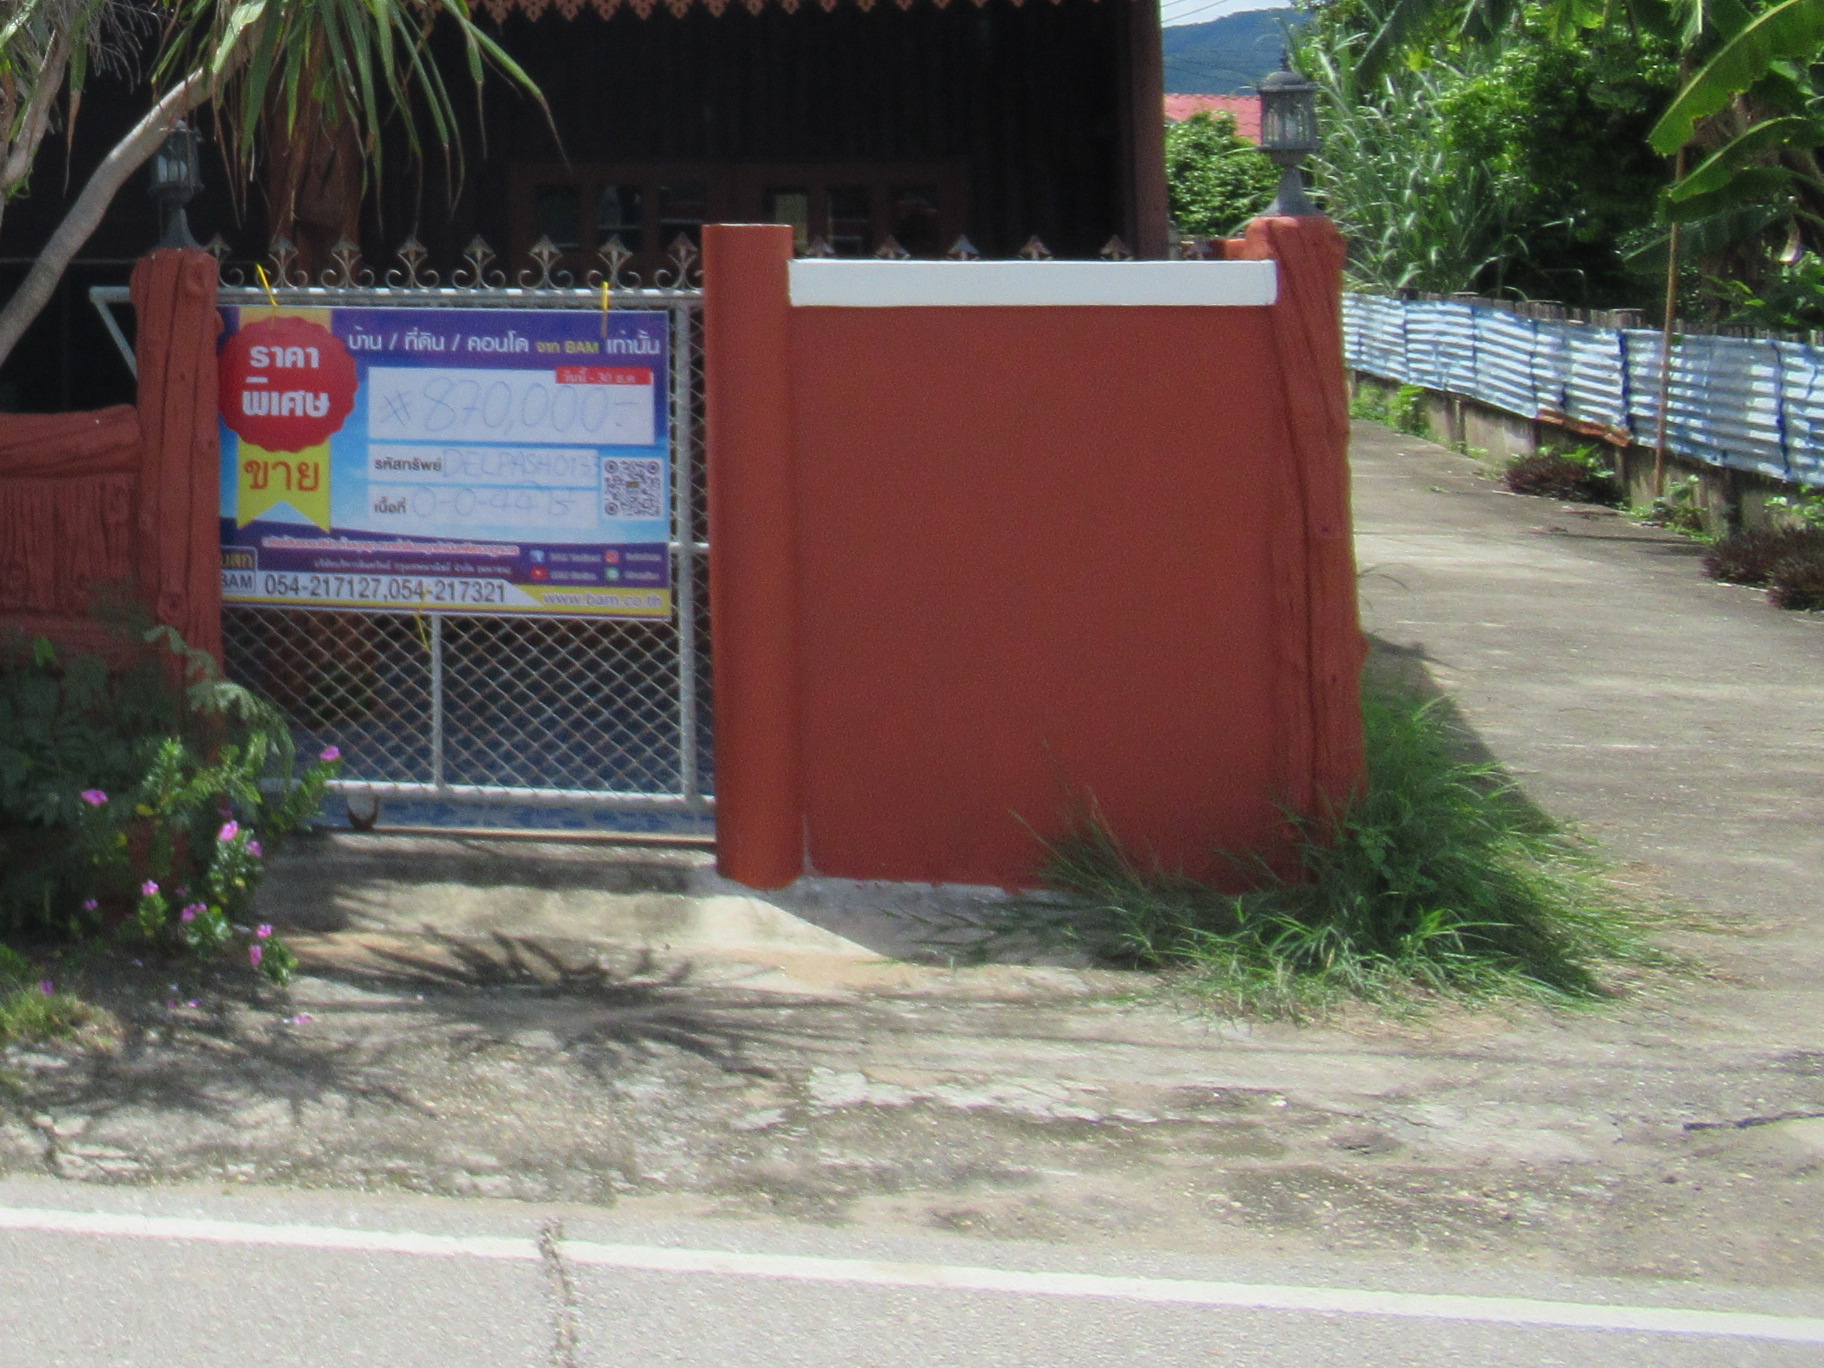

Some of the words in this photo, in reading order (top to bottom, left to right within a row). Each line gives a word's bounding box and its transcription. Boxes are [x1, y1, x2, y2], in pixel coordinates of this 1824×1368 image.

[348, 325, 382, 351] บ้าน
[389, 333, 399, 351] /
[404, 326, 445, 351] ที่ดิน
[451, 333, 462, 352] /
[467, 330, 530, 352] คอนโด
[564, 340, 600, 354] BAM
[606, 329, 662, 355] เท่านั้น
[249, 345, 320, 369] ราคา
[242, 376, 331, 418] พิเศษ
[243, 458, 321, 493] ขาย
[374, 455, 443, 472] รหัสทรัพย์
[374, 495, 407, 515] เนื้อที่
[264, 573, 505, 603] 054-217127,054-217321
[542, 592, 663, 609] www.bam.co.th
